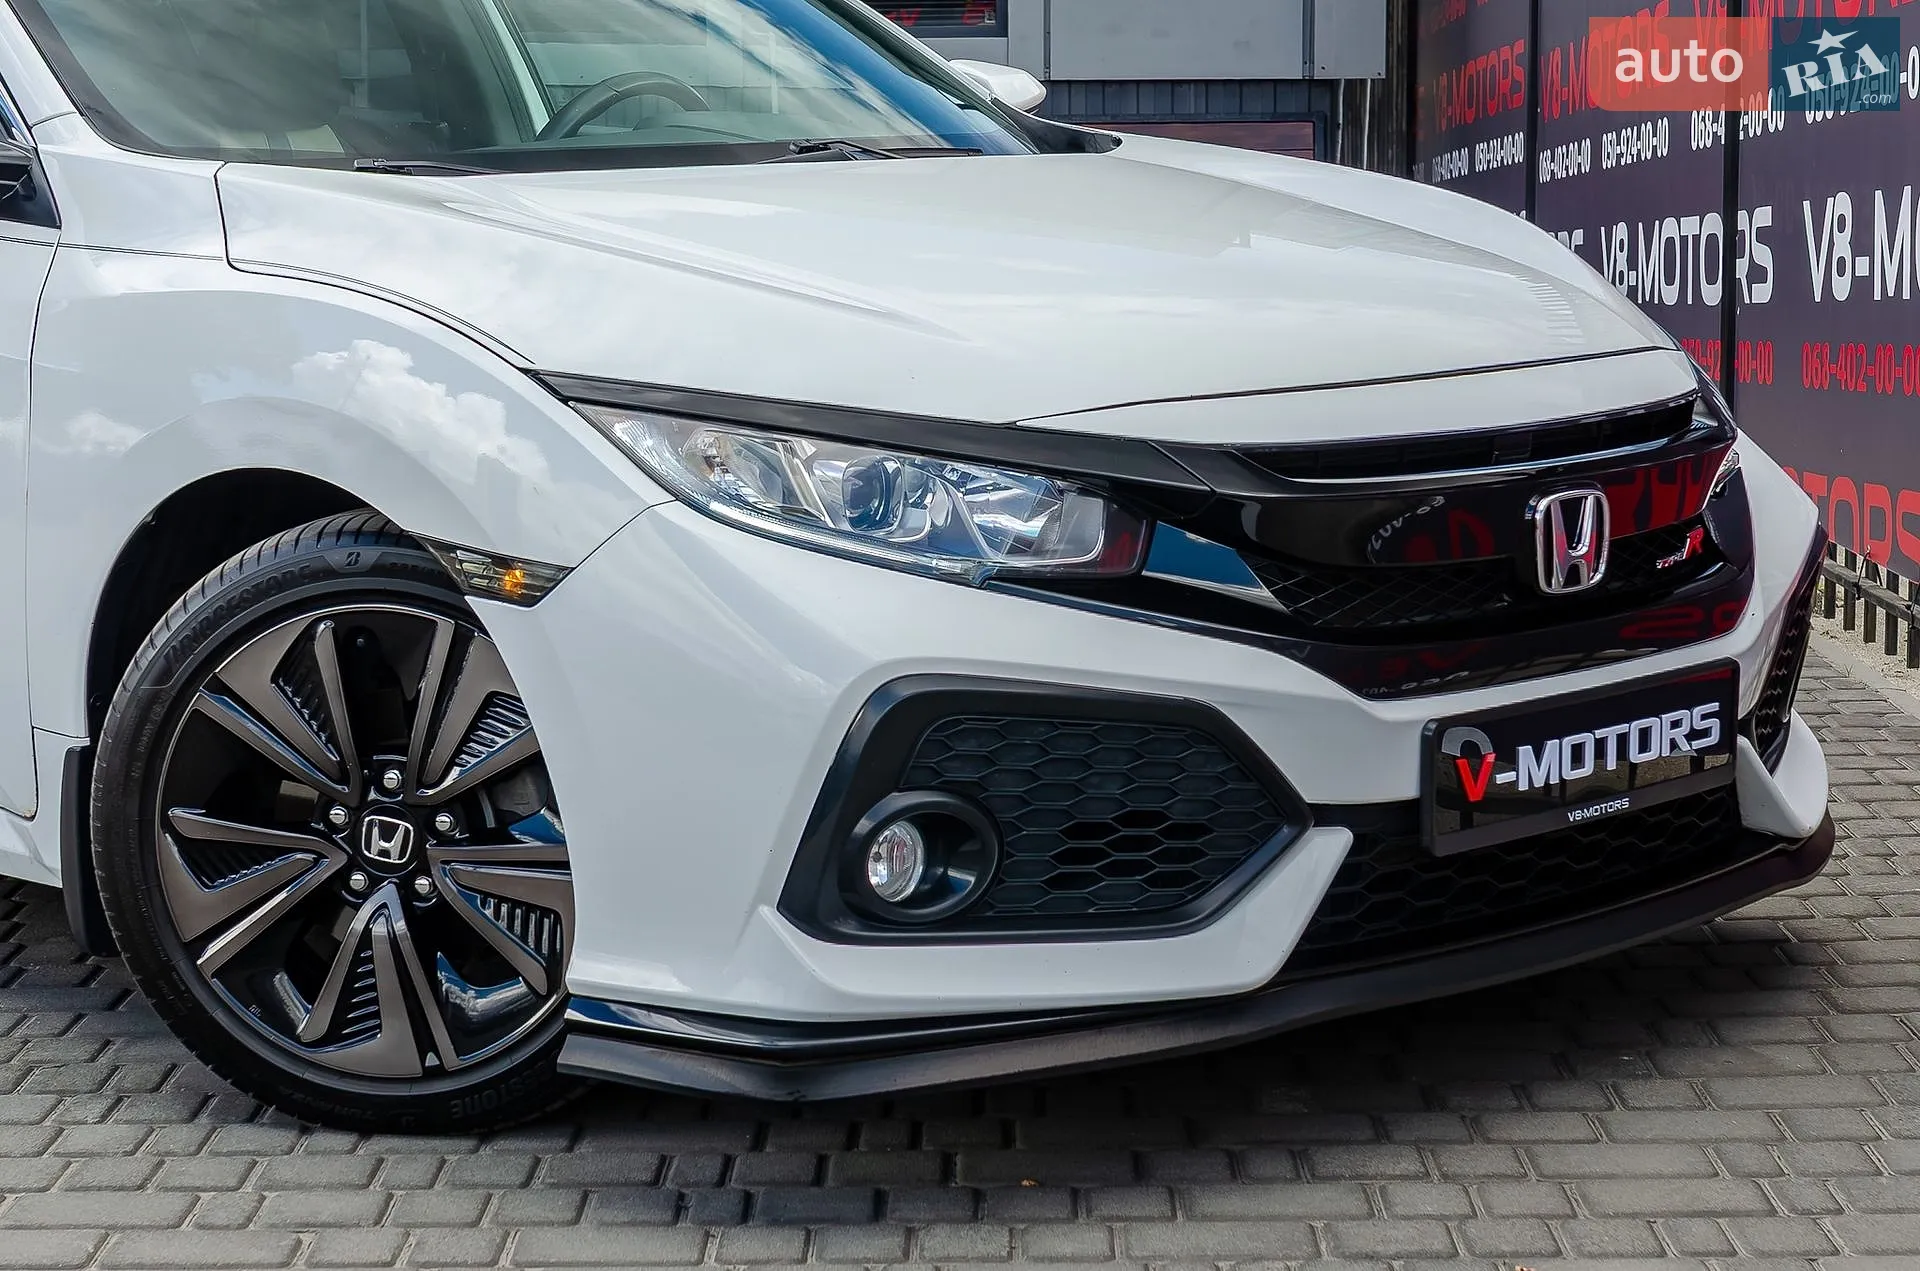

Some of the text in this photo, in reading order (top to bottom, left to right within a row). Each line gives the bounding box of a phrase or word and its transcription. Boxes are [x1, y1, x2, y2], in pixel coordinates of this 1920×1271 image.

[1433, 38, 1525, 133] V8-MOTORS
[1602, 117, 1669, 170] 050-924-00-00
[1567, 798, 1630, 822] V8-MOTORS
